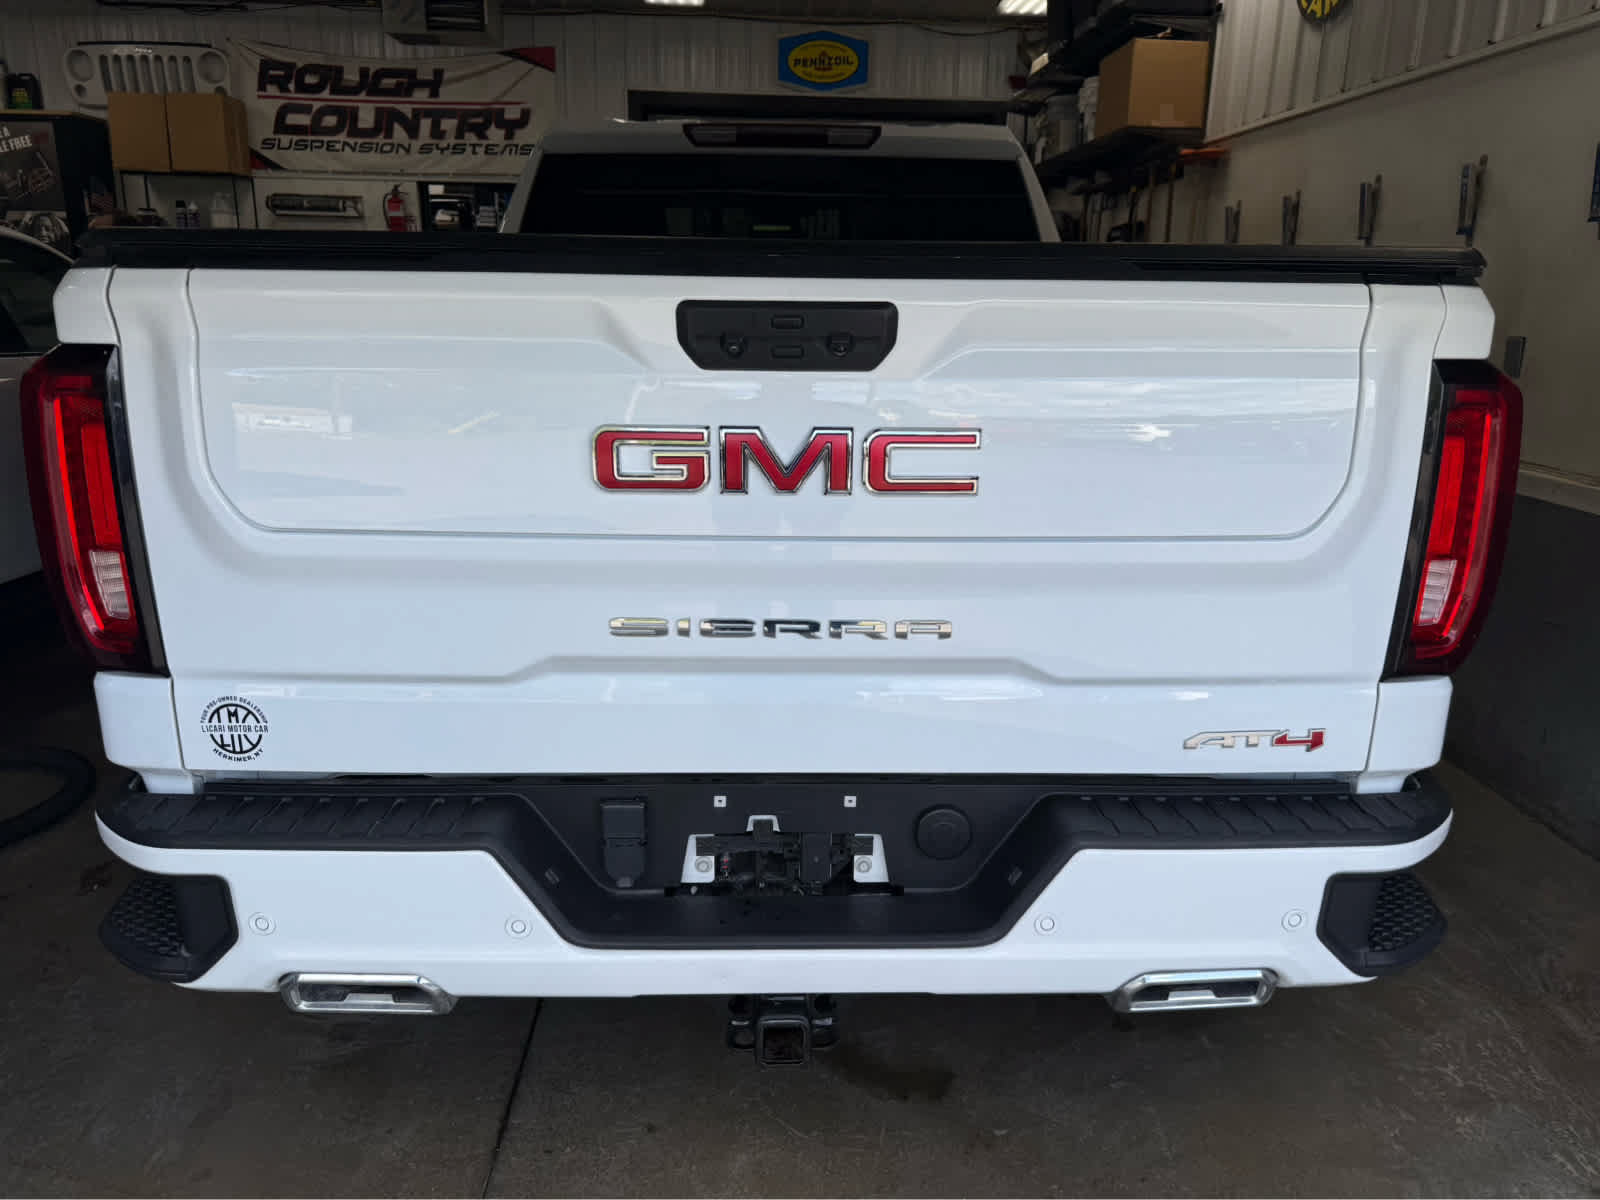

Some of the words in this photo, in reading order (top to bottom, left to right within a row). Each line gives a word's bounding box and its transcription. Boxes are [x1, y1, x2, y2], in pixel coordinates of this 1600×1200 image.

[793, 54, 855, 68] PENNZOIL
[257, 58, 445, 99] ROUGH
[273, 102, 531, 141] COUNTRY
[260, 137, 412, 153] SUSPENSION
[418, 142, 535, 156] SYSTEMS
[591, 425, 982, 497] GMC
[608, 616, 953, 640] SIERRA
[201, 724, 226, 733] LICARI
[227, 724, 252, 733] MOTOR
[254, 724, 269, 733] CAR
[1183, 728, 1326, 752] AT4
